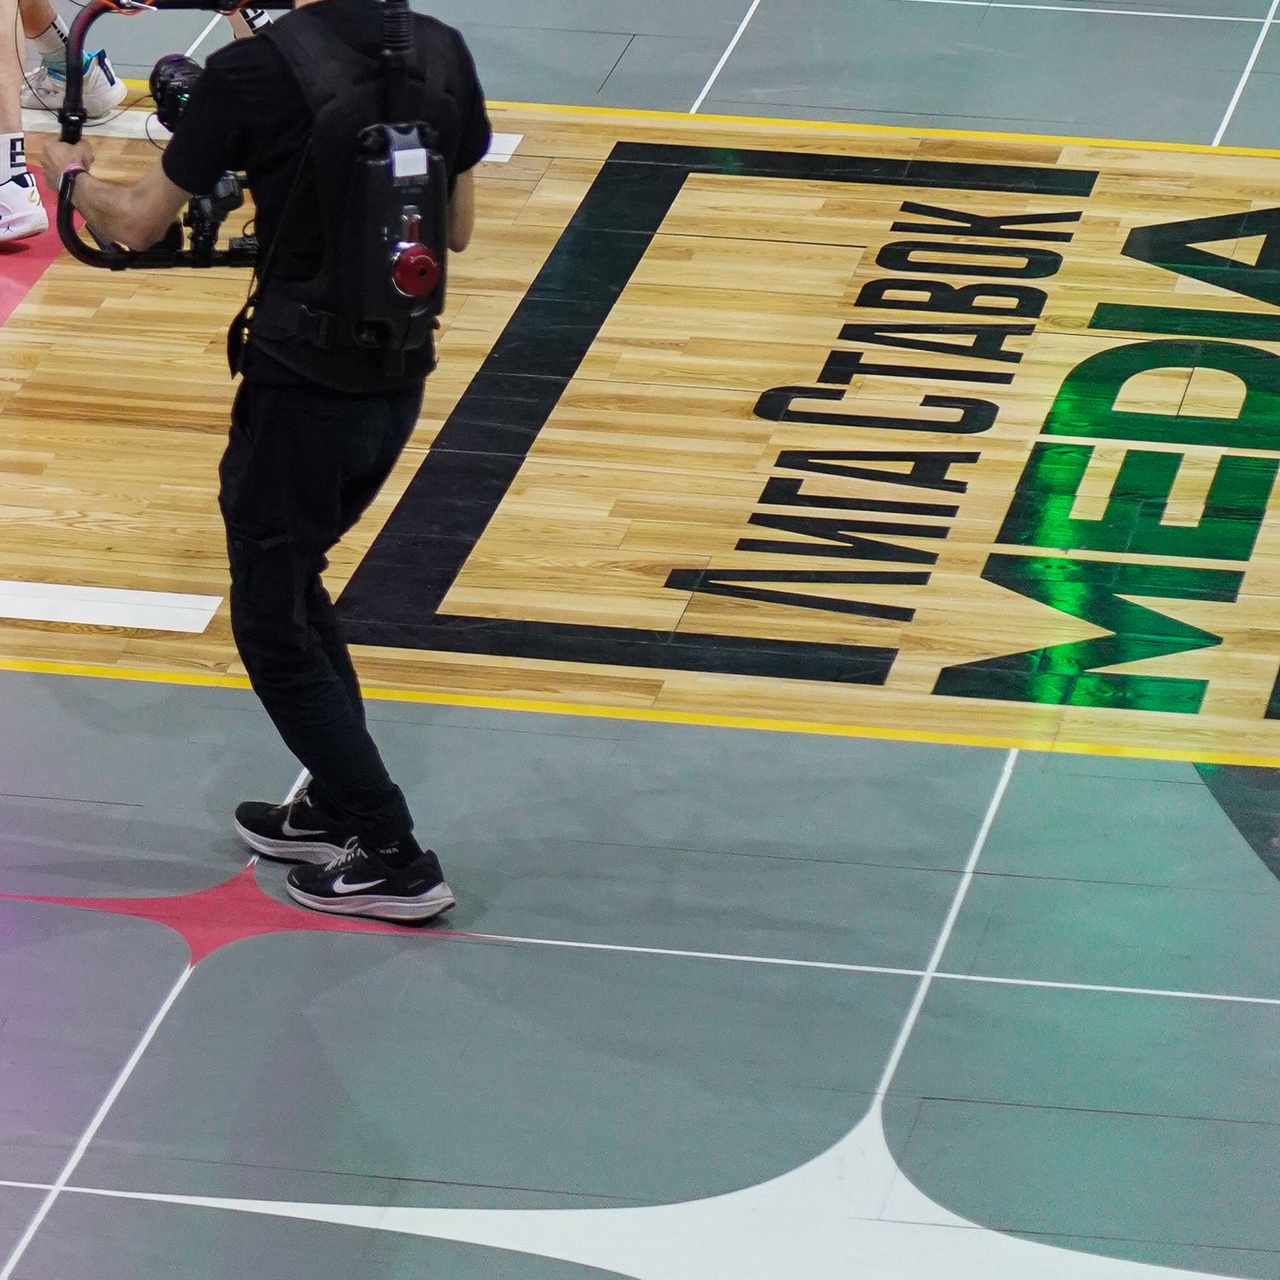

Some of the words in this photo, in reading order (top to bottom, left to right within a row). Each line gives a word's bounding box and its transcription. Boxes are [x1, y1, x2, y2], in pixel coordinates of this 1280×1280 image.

[752, 200, 1083, 435] СТАВОК
[663, 450, 982, 623] ЛИГА
[930, 206, 1280, 715] MEDIA
